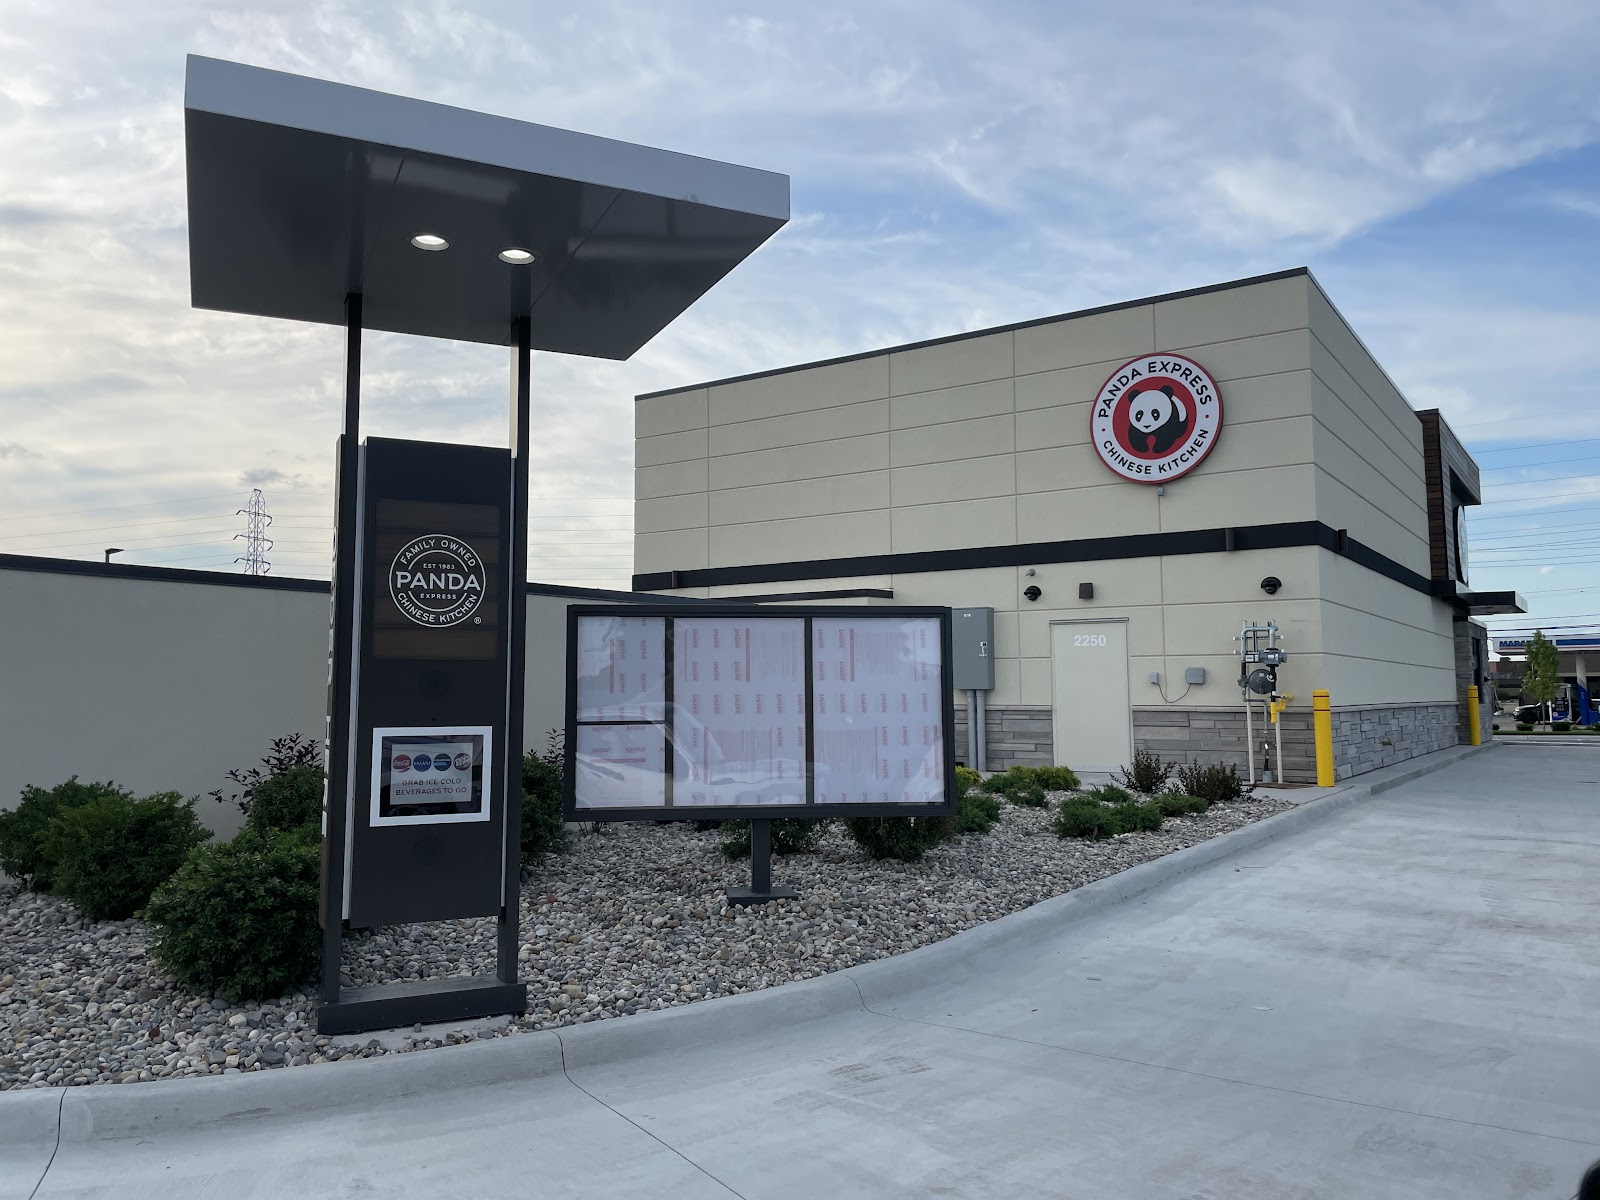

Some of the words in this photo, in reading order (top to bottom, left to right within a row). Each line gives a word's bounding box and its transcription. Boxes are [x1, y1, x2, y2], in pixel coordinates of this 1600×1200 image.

[1098, 368, 1142, 418] PANDA
[1148, 361, 1212, 405] EXPRESS
[1103, 440, 1152, 475] CHINESE
[1158, 429, 1209, 474] KITCHEN
[400, 539, 436, 565] FAMILY
[441, 540, 476, 567] OWNED
[395, 571, 481, 591] PANDA
[398, 592, 436, 622] CHINESE
[439, 594, 478, 623] KITCHEN
[1074, 634, 1107, 647] 2250
[395, 788, 441, 796] BEVERAGES
